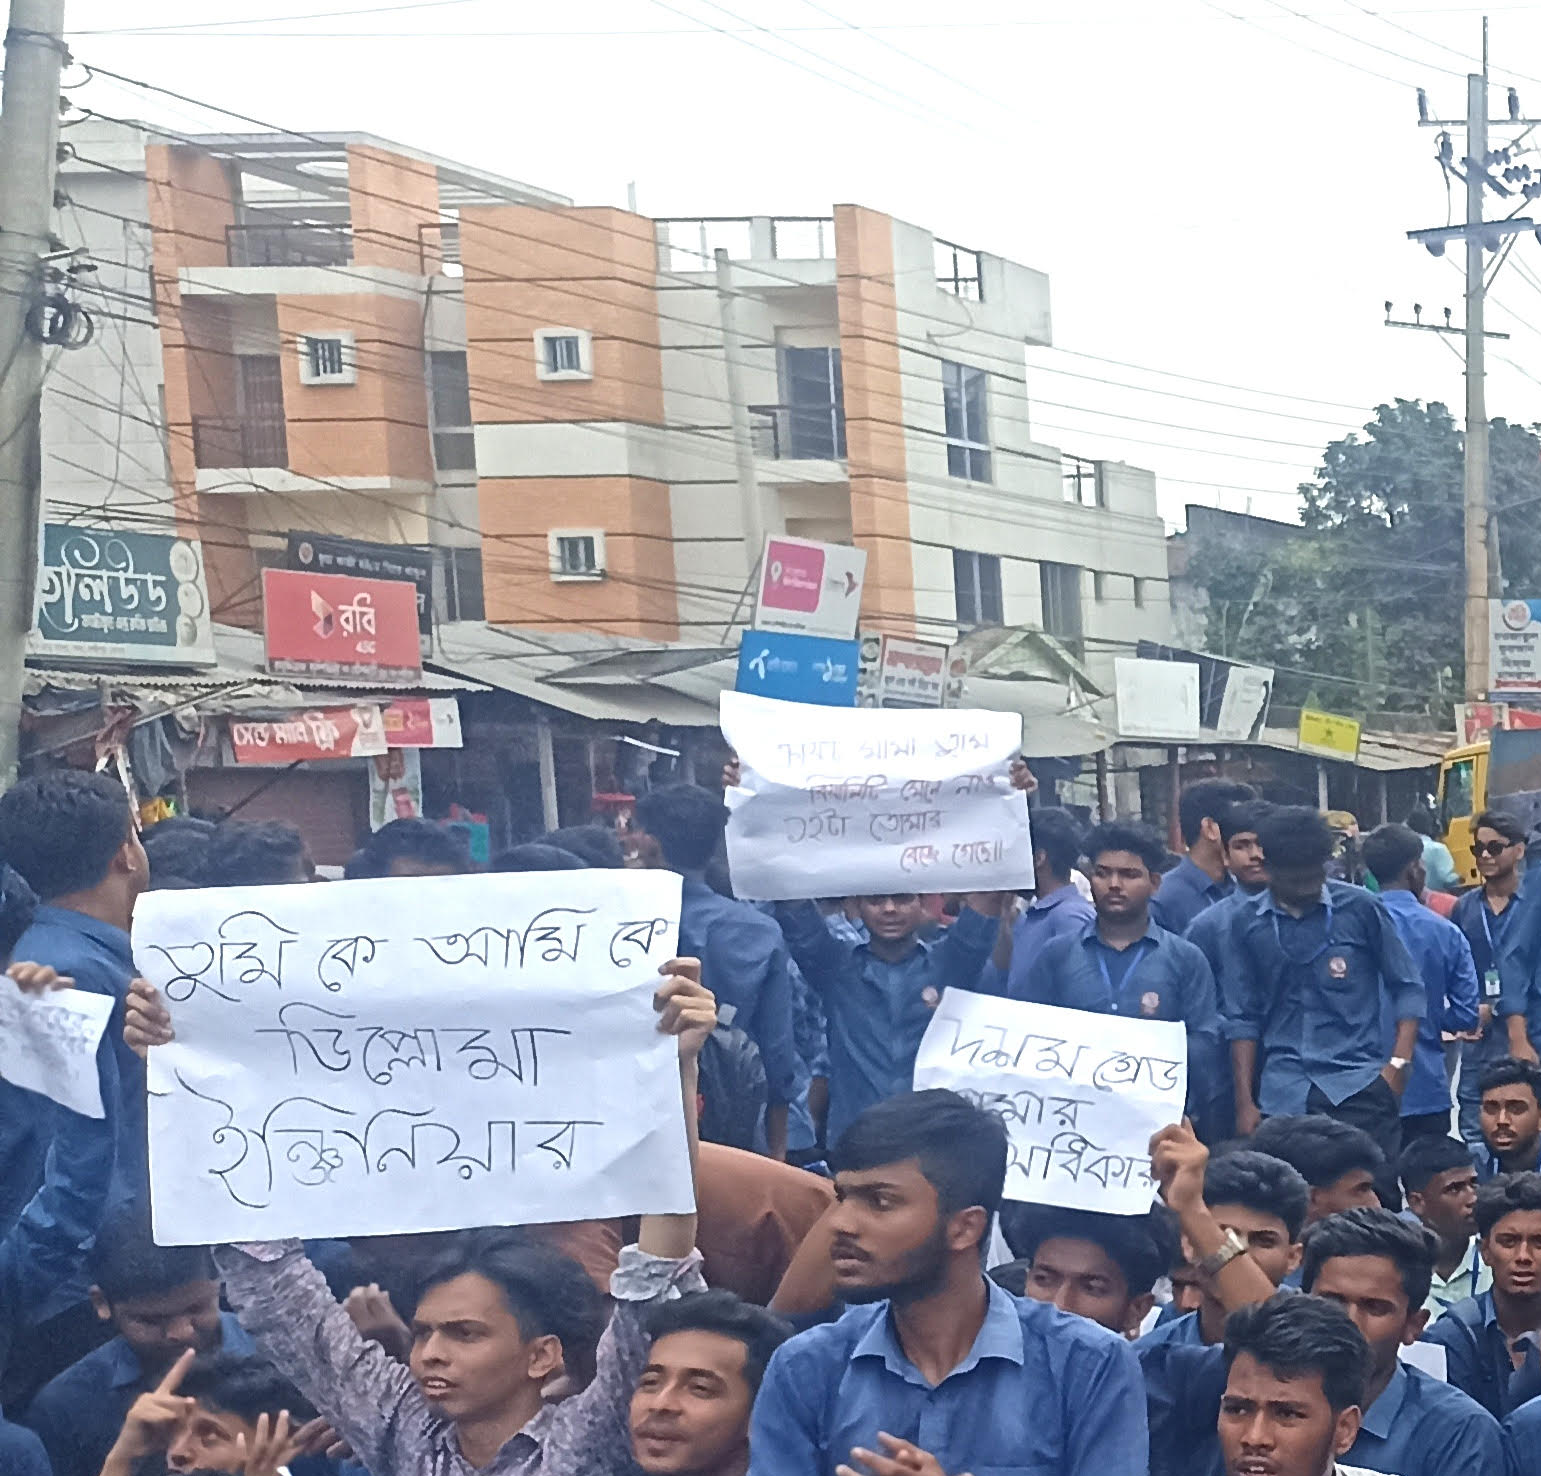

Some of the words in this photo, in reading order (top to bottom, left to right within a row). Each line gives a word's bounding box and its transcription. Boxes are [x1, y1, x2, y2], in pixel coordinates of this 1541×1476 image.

[338, 592, 377, 638] রবি
[147, 911, 300, 1002] তুমি
[317, 935, 389, 992] কে
[414, 907, 599, 969] আমি
[609, 916, 672, 968] কে
[254, 1001, 572, 1086] ডিপ্লোমা
